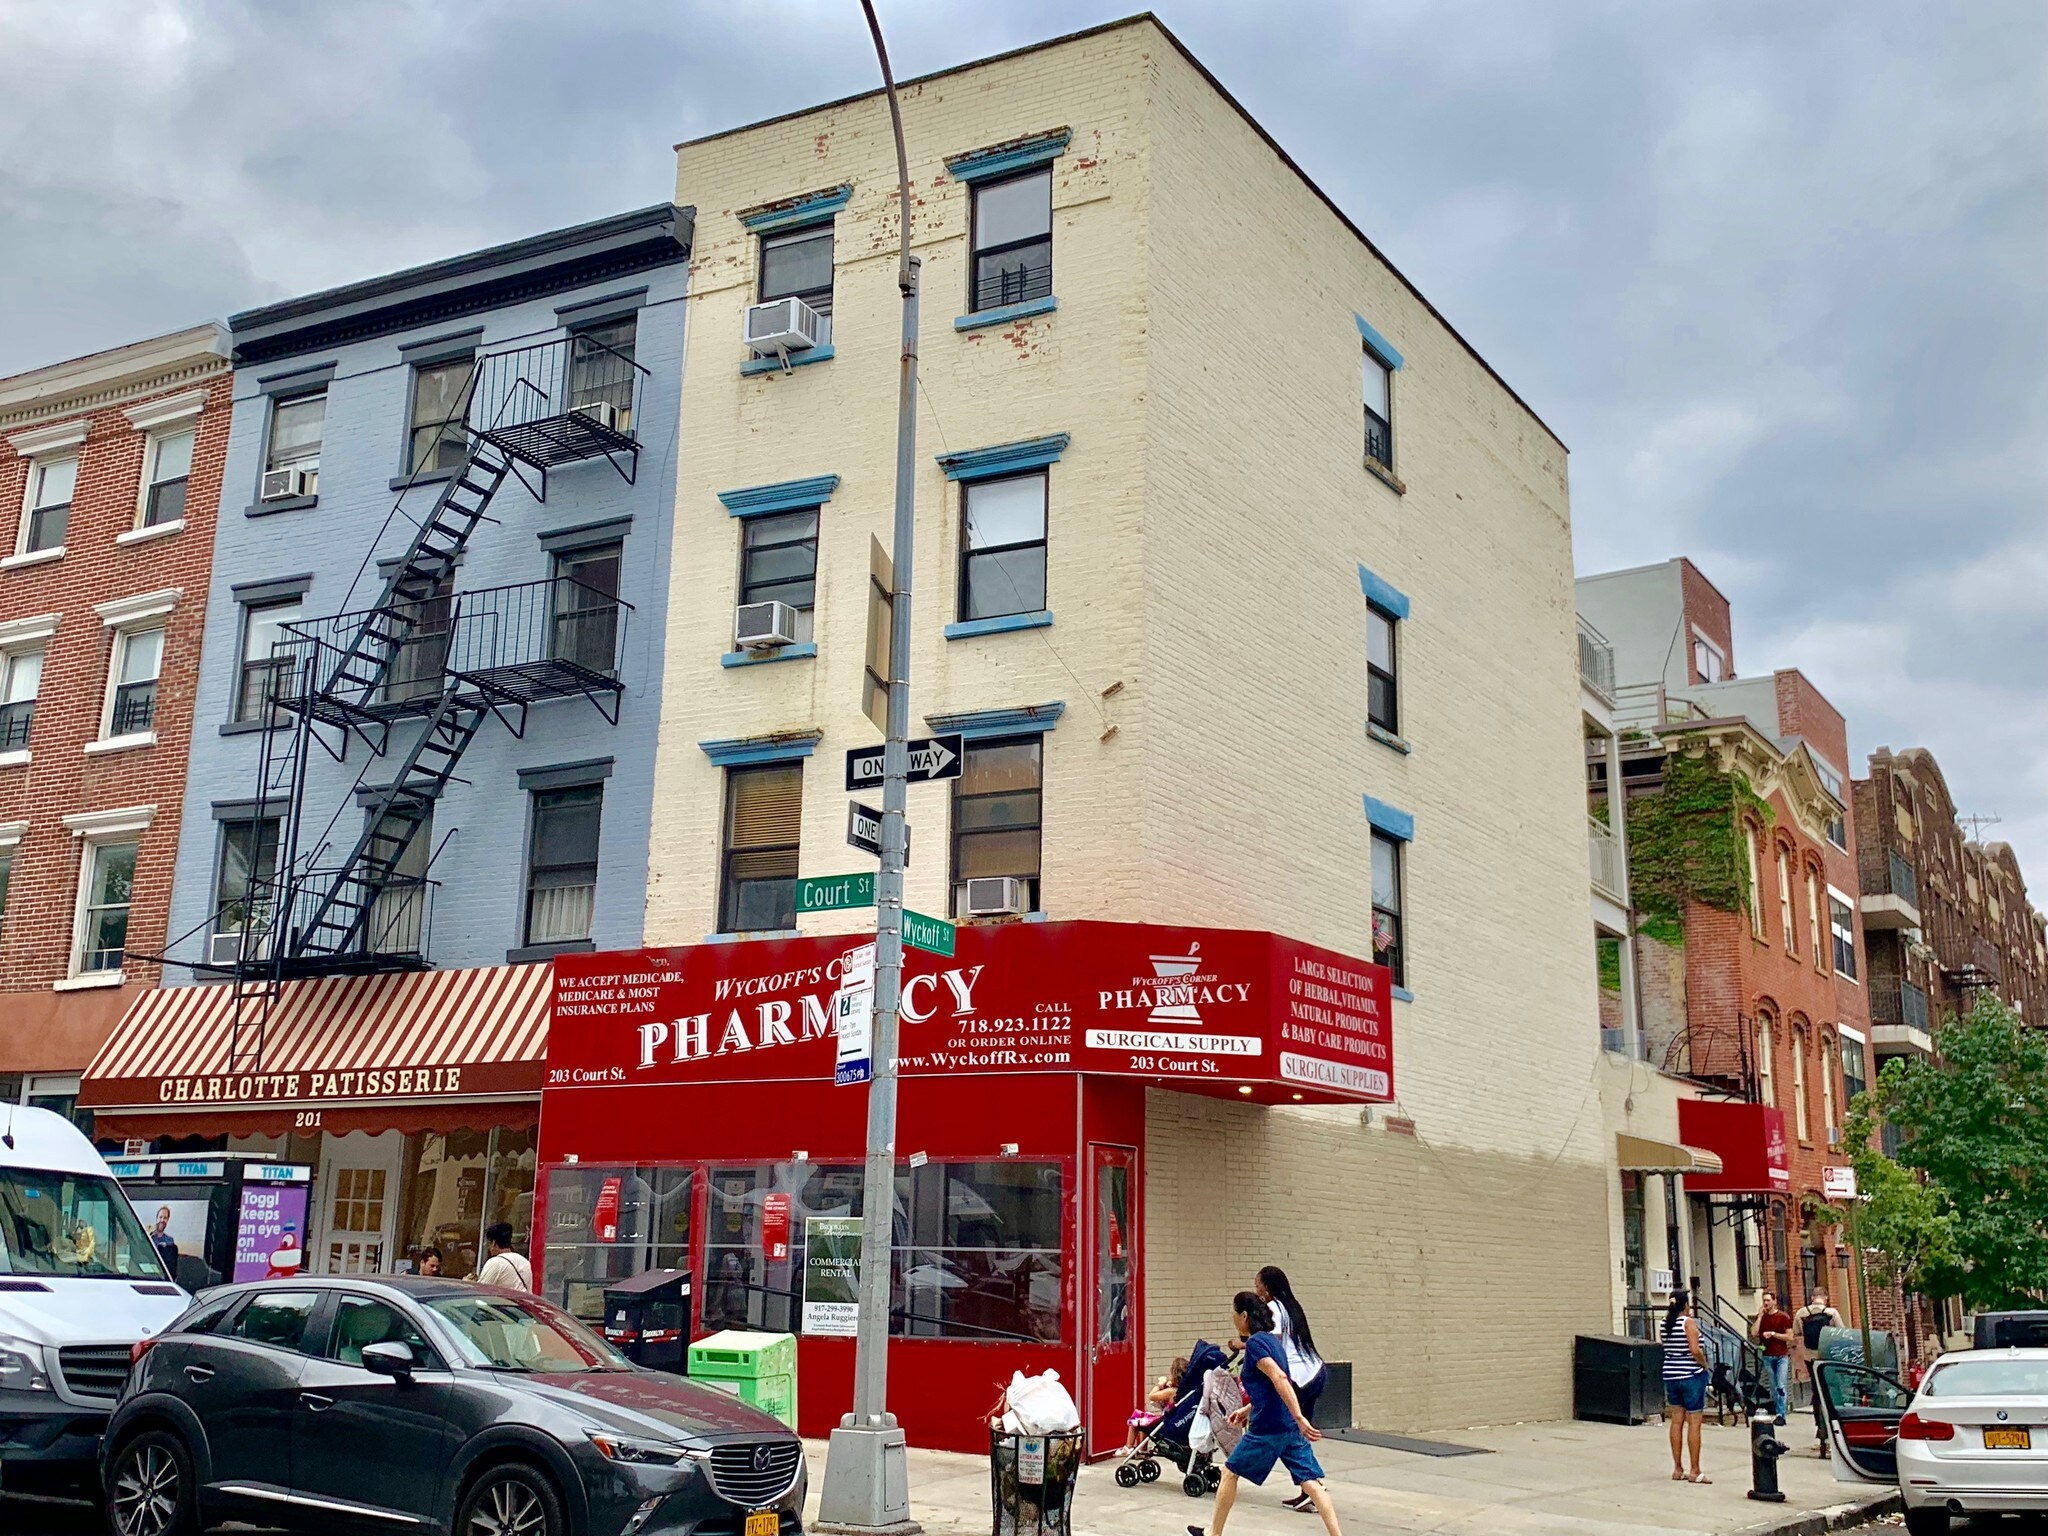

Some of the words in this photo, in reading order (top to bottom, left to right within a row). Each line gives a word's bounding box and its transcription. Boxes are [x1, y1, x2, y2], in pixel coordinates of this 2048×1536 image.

[862, 758, 884, 776] ON
[910, 749, 944, 770] WAY
[857, 817, 877, 841] ONE
[803, 879, 850, 907] Court
[858, 877, 870, 894] St
[903, 915, 940, 947] Wyckoff
[942, 930, 949, 942] St
[559, 977, 576, 988] WE
[577, 974, 620, 987] ACCEPT
[1182, 973, 1218, 984] CORNER
[1294, 956, 1325, 980] LARGE
[1327, 966, 1373, 993] SELECTION
[714, 966, 822, 1002] WYCKOFF'S
[1289, 978, 1303, 996] OF
[558, 989, 615, 1003] MEDICARE
[616, 989, 626, 999] &
[628, 987, 660, 999] MOST
[1098, 983, 1251, 1010] PHARMACY
[556, 1003, 618, 1017] INSURANCE
[620, 1001, 655, 1014] PLANS
[842, 998, 849, 1015] 2
[1035, 1003, 1072, 1013] CALL
[636, 964, 985, 1070] PHARMCY
[958, 1016, 1071, 1034] 718.923.1122
[1290, 1000, 1333, 1026] NATURAL
[1335, 1011, 1378, 1036] PRODUCTS
[947, 1038, 967, 1049] OR
[969, 1036, 1016, 1048] ORDER
[1019, 1035, 1072, 1046] ONLINE
[1096, 1032, 1185, 1049] SURGICAL
[1188, 1036, 1251, 1053] SUPPLY
[1281, 1022, 1289, 1038] &
[1291, 1024, 1316, 1044] BABY
[1318, 1030, 1342, 1050] CARE
[1344, 1036, 1386, 1060] PRODUCTS
[898, 1050, 1071, 1069] ww.WyckoffRx.com
[1130, 1055, 1154, 1070] 203
[1157, 1057, 1199, 1073] Court
[1201, 1058, 1219, 1073] St.
[548, 1069, 570, 1083] 203
[572, 1068, 608, 1082] Court
[610, 1066, 627, 1080] St.
[1285, 1056, 1338, 1083] SURGICAL
[1340, 1067, 1384, 1091] SUPPLIES
[159, 1074, 300, 1101] CHARLOTTE
[308, 1067, 461, 1096] PATISSERIE
[295, 1112, 322, 1127] 201
[178, 1163, 207, 1175] TITAN
[261, 1166, 294, 1179] TITAN
[242, 1190, 280, 1208] Toggl
[240, 1205, 280, 1223] keeps
[239, 1223, 256, 1234] an
[258, 1224, 281, 1238] eye
[237, 1236, 255, 1247] on
[235, 1247, 270, 1263] time.
[820, 1268, 852, 1278] RENTAL
[807, 1313, 830, 1322] Angela
